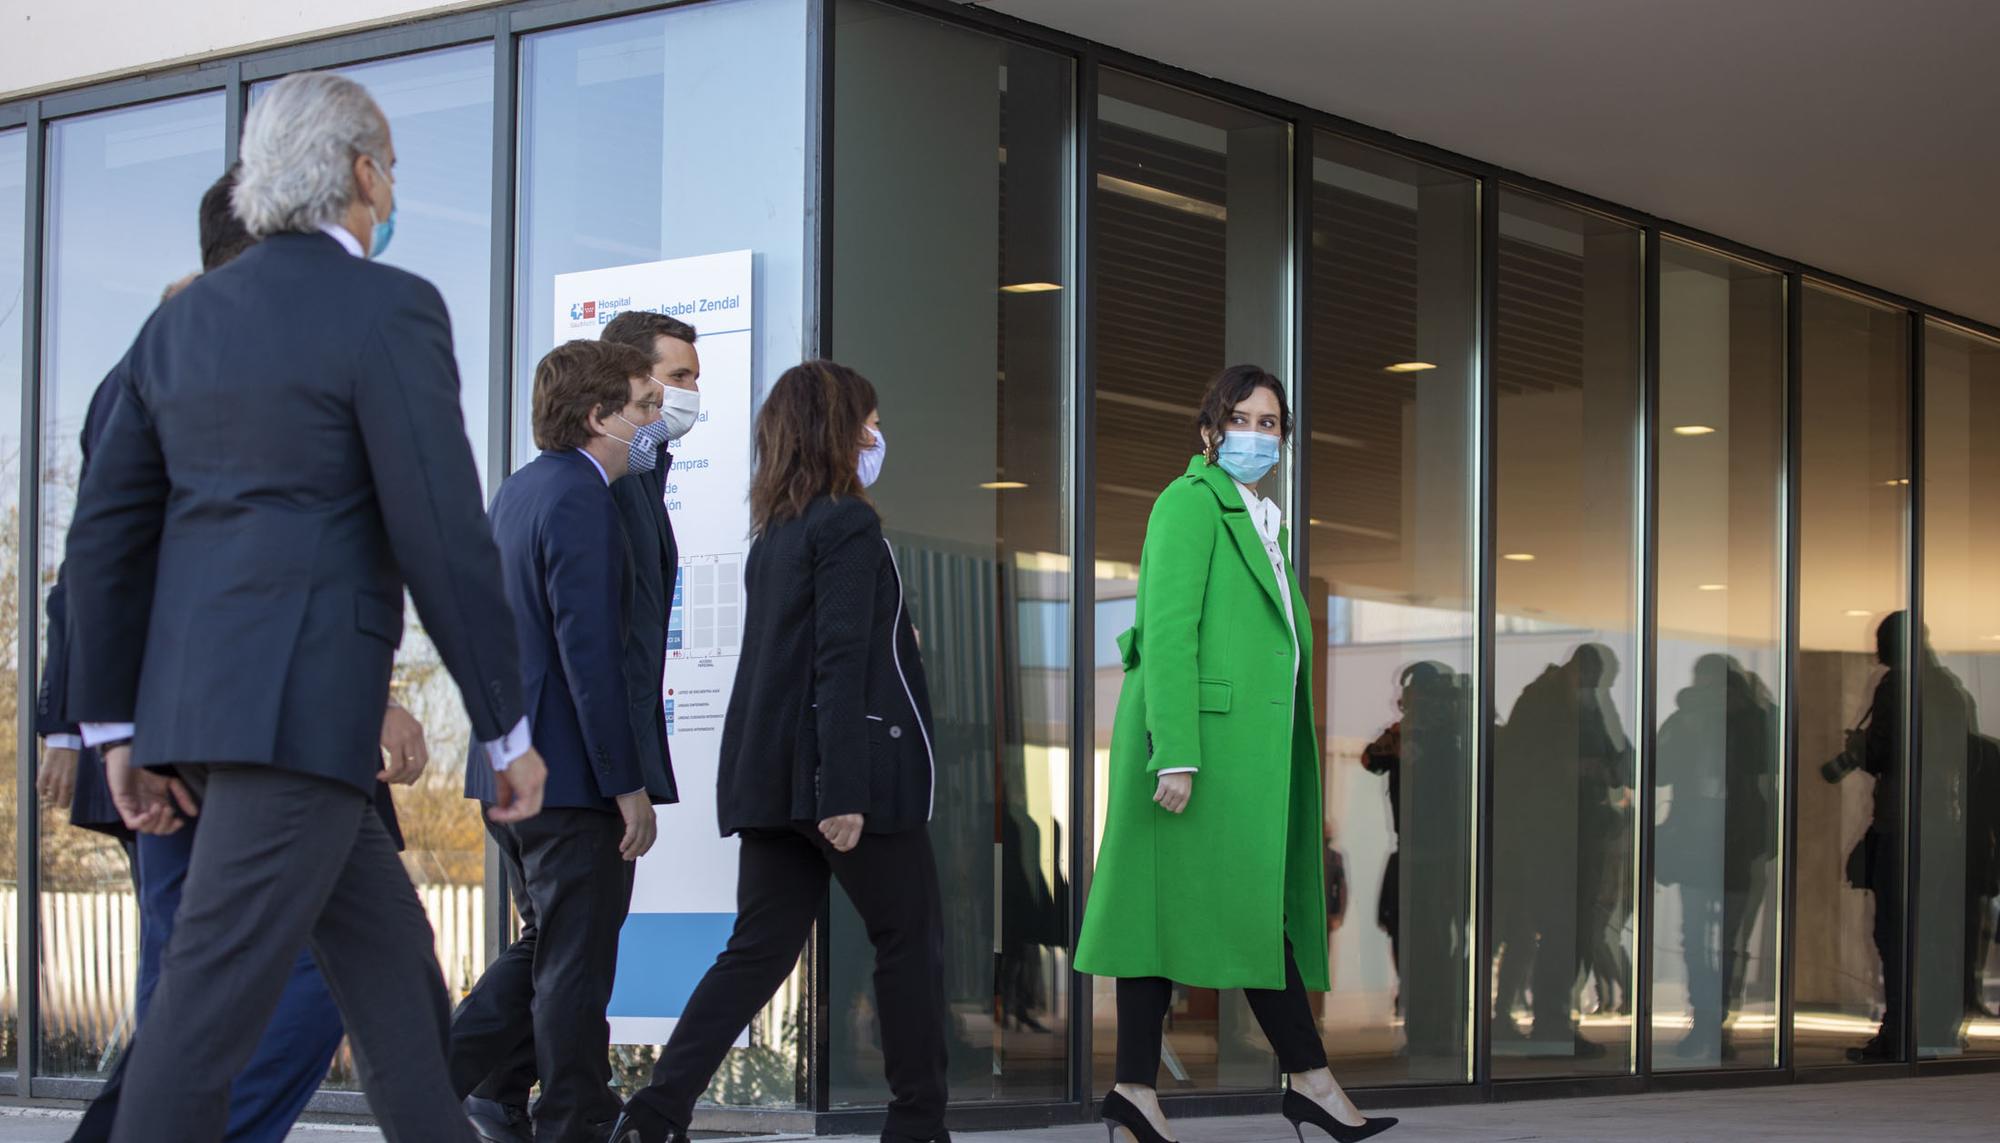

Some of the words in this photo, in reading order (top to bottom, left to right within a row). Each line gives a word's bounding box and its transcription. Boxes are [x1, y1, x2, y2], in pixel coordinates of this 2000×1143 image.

[598, 296, 631, 309] Hospital
[661, 300, 696, 316] Isabel
[699, 295, 739, 312] Zendal
[670, 459, 709, 472] ompras
